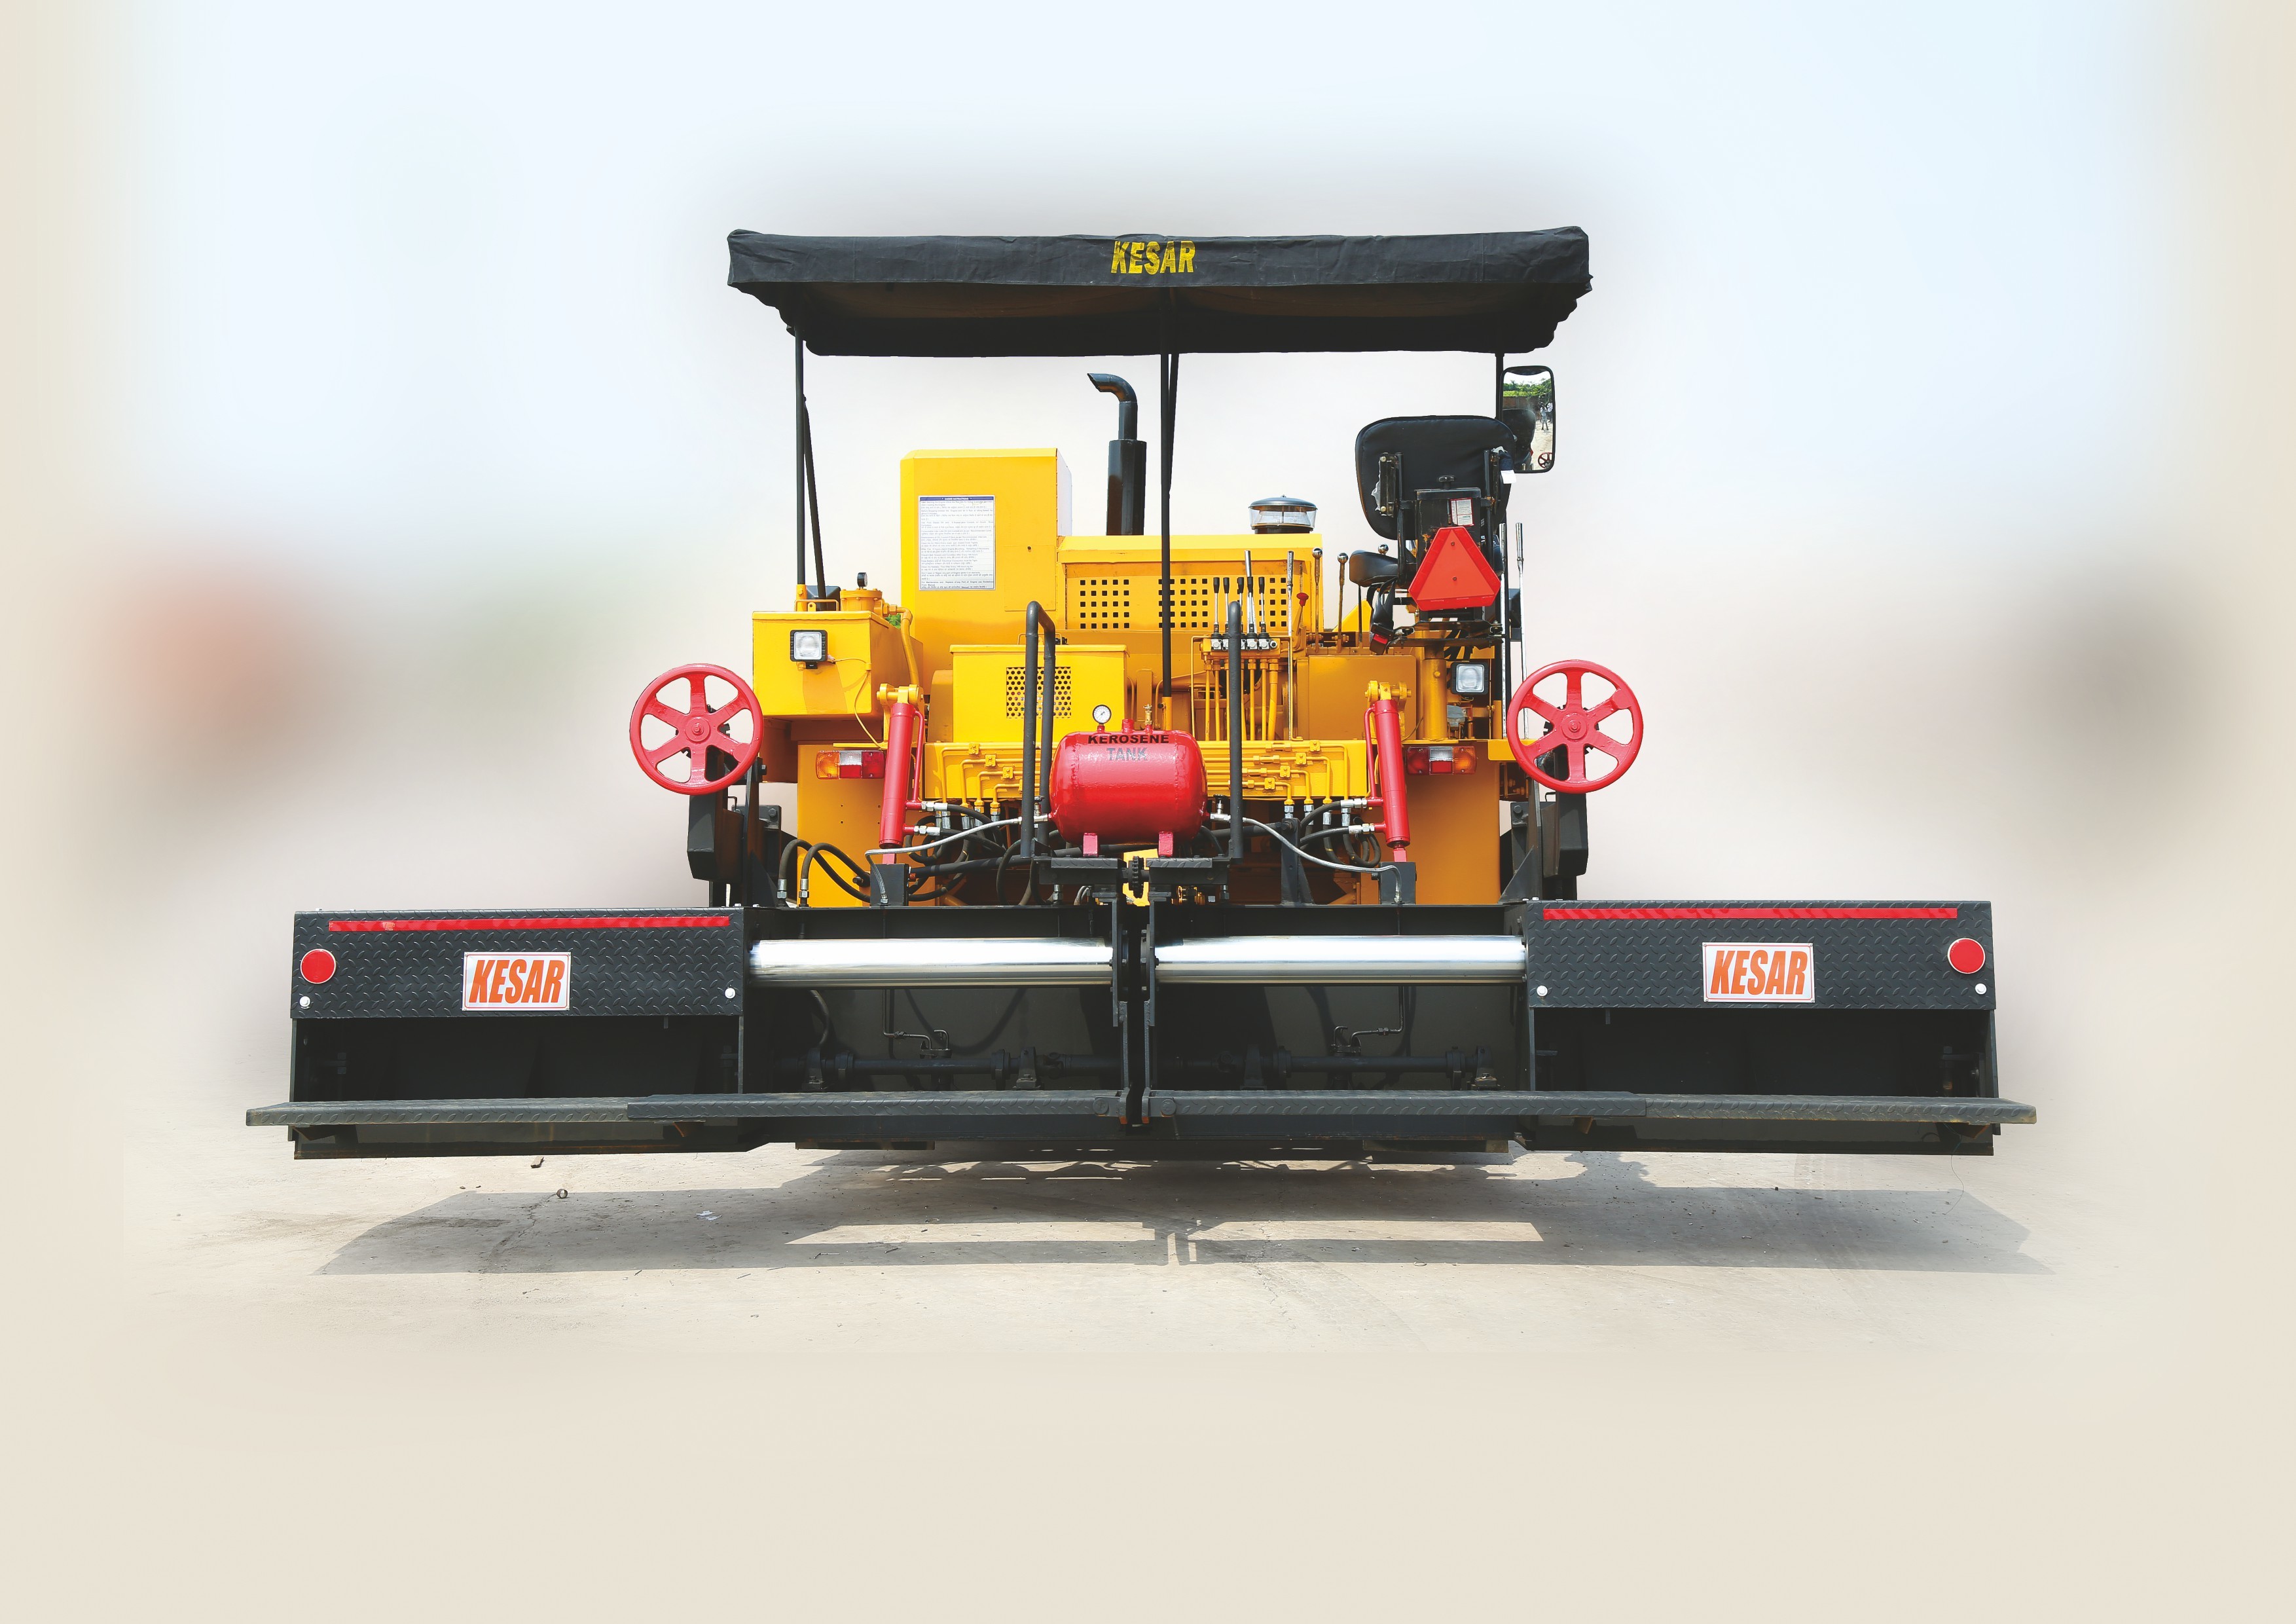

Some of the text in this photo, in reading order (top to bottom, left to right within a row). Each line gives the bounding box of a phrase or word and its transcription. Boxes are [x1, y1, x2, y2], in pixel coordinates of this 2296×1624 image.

[1111, 240, 1195, 275] KESAR
[1087, 734, 1169, 744] KEROSENE
[1106, 747, 1148, 761] TANK
[469, 959, 565, 1004] KESAR
[1710, 950, 1808, 995] KESAR
